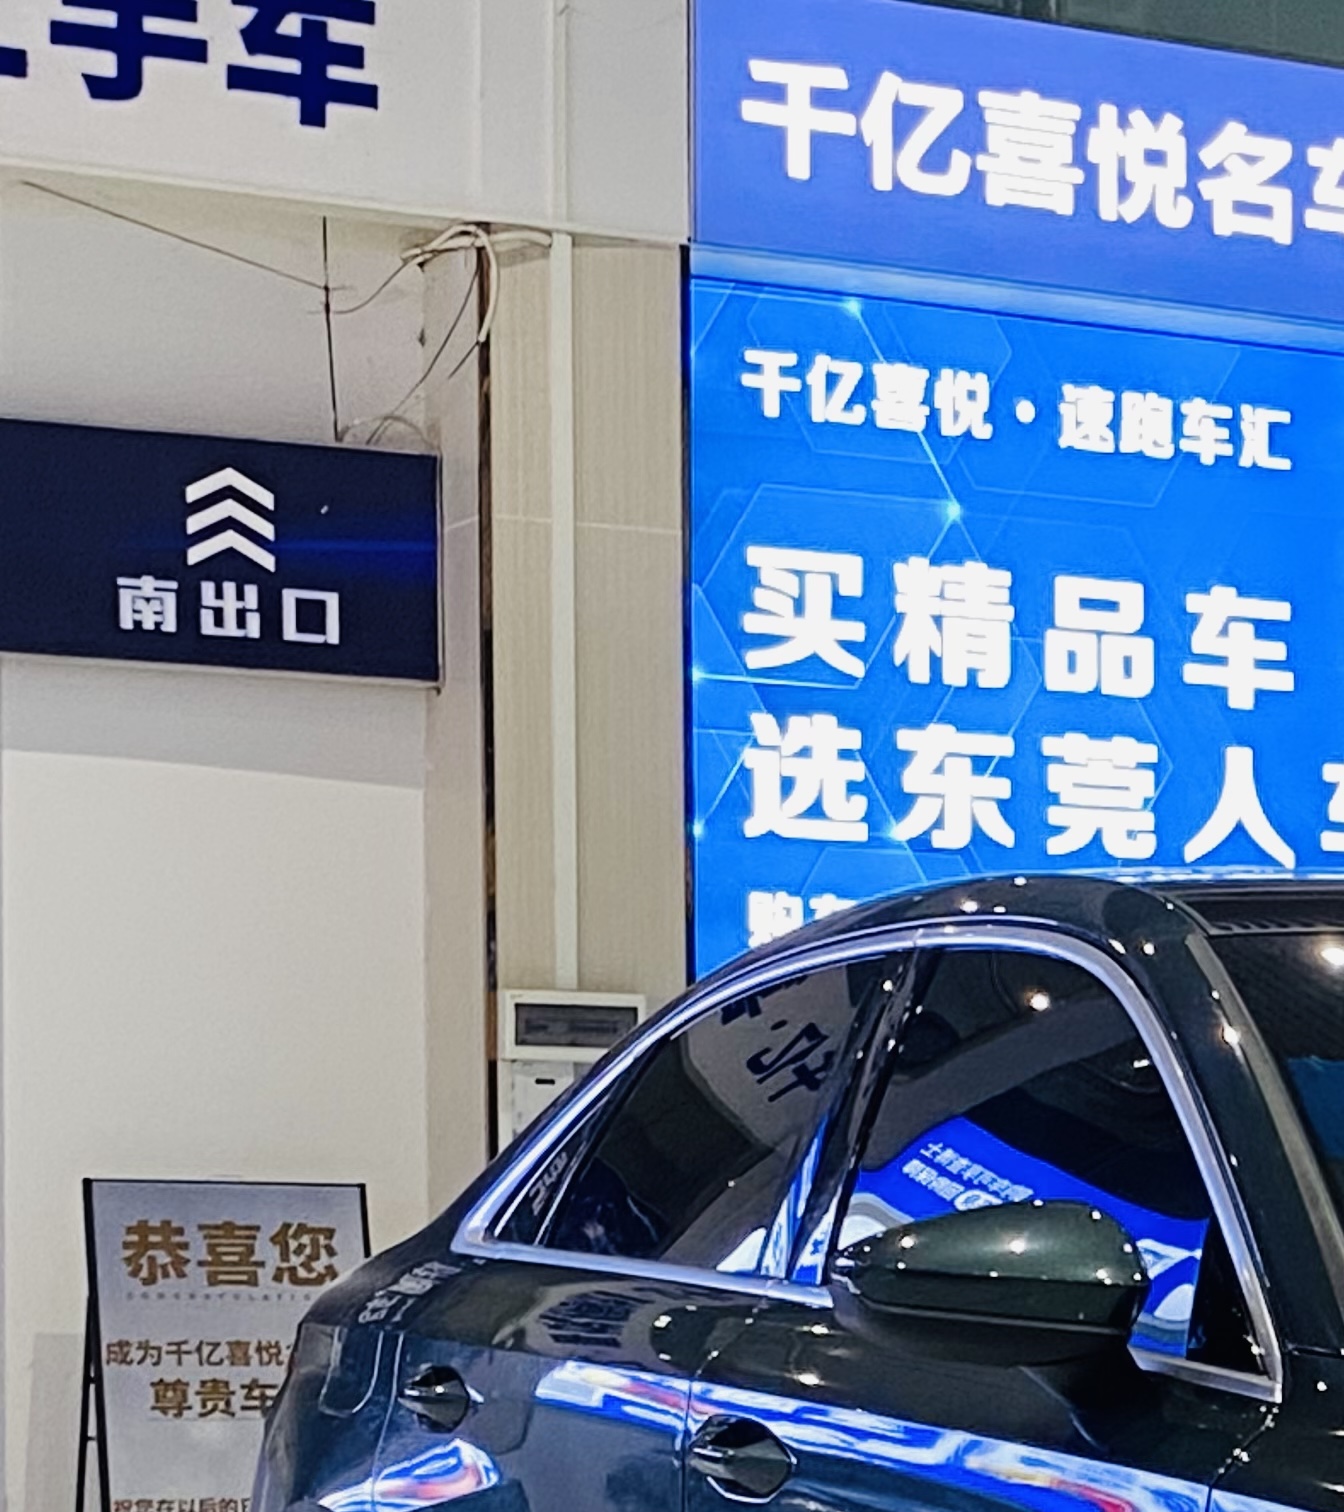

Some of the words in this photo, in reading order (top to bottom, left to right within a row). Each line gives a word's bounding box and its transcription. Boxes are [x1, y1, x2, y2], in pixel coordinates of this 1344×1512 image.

[0, 0, 378, 128] 手车
[117, 575, 340, 646] 南出口
[743, 545, 1296, 710] 买精品车
[122, 1220, 340, 1287] 恭喜您
[106, 1339, 292, 1367] 成为千亿喜悦
[149, 1377, 282, 1419] 尊贵车
